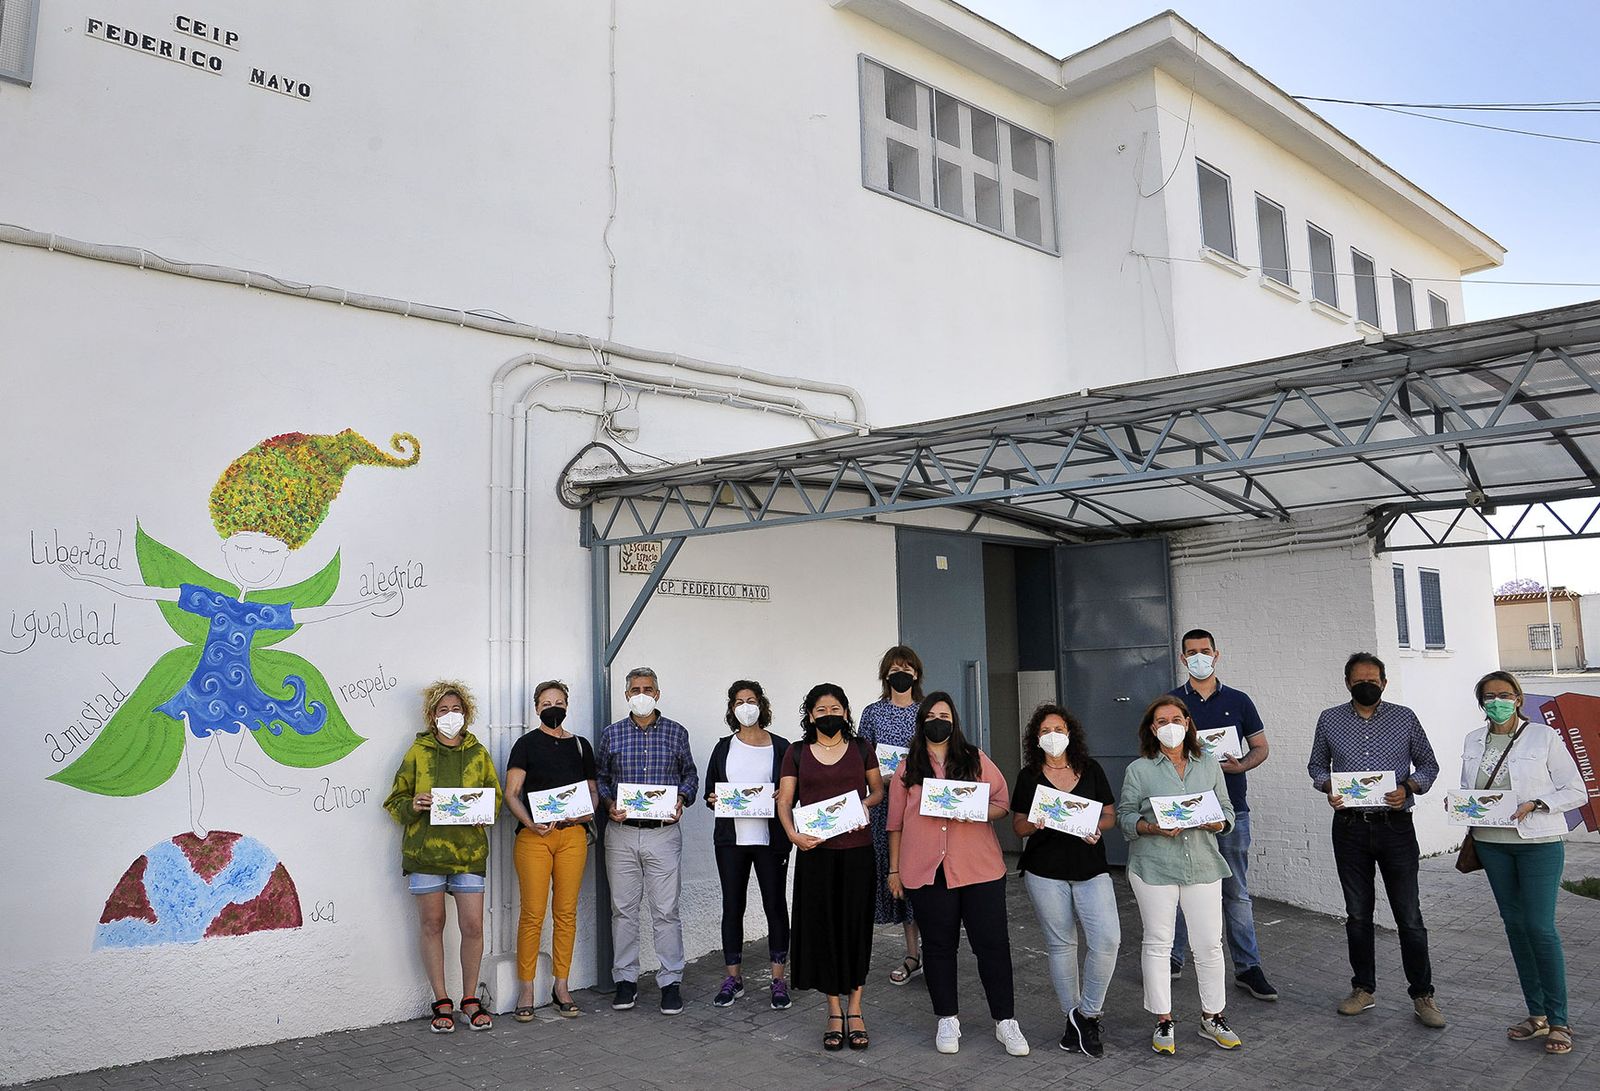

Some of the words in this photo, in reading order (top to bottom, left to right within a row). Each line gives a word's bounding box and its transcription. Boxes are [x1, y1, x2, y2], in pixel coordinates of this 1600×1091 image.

[175, 15, 239, 46] CEIP
[87, 18, 222, 72] FEDERICO
[250, 67, 311, 99] MAYO
[359, 561, 427, 618] alegría
[660, 581, 674, 593] CP
[682, 582, 735, 597] FEDERICO
[742, 585, 767, 598] MAYO
[0, 602, 121, 655] igualdad
[338, 663, 399, 708] respeto
[44, 672, 130, 763] amistad
[1568, 727, 1596, 782] PRINCIPITO
[313, 777, 371, 812] amor
